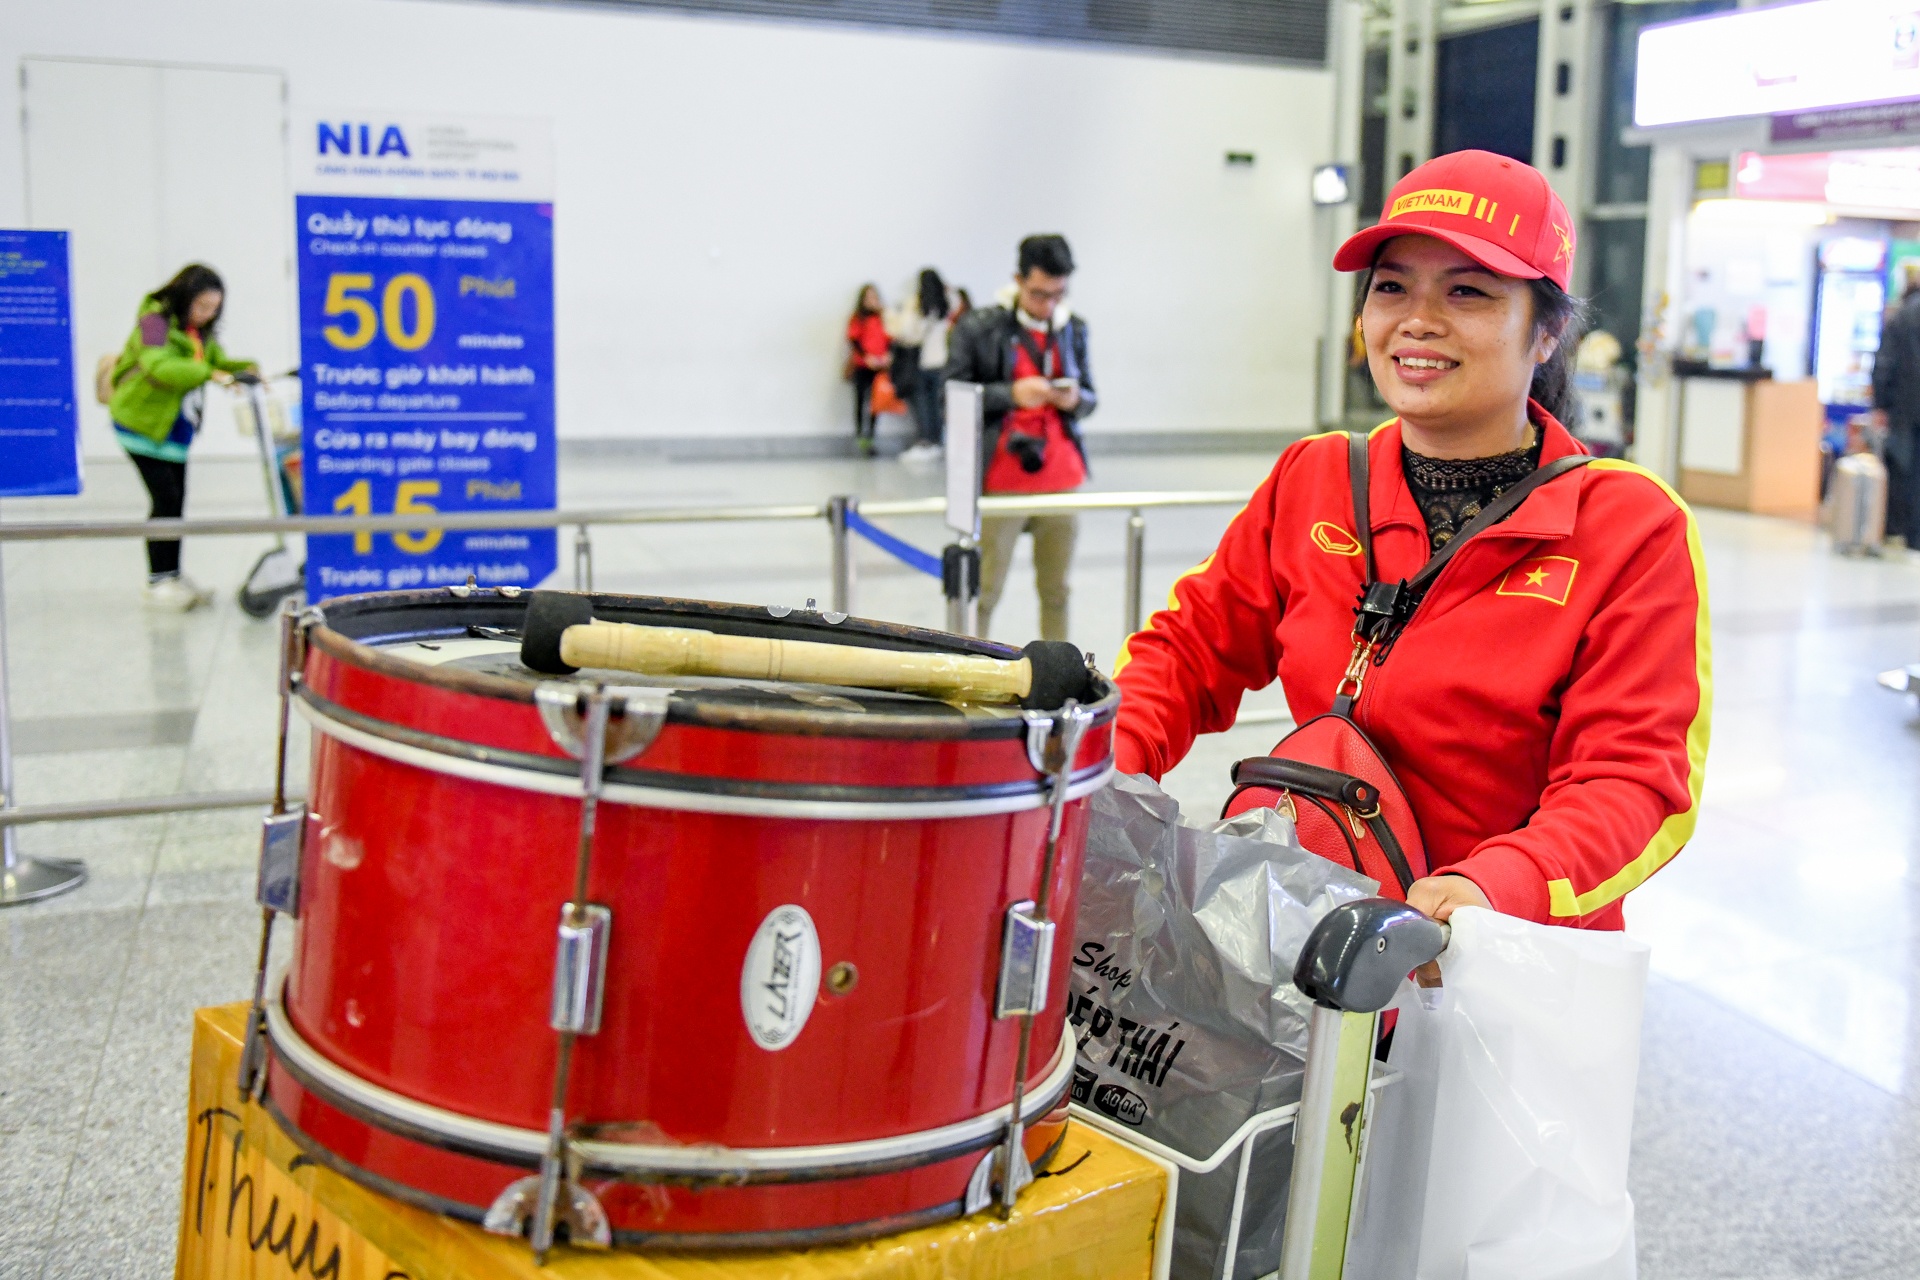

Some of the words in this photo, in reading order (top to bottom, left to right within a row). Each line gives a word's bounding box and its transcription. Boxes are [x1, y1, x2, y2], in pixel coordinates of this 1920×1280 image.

[317, 122, 411, 158] NIA
[1397, 193, 1462, 211] VIETNAM
[323, 273, 436, 350] 50
[333, 479, 445, 555] 15
[763, 932, 802, 1019] LAZER
[1073, 942, 1132, 991] Shop
[1107, 1017, 1186, 1087] THÁI
